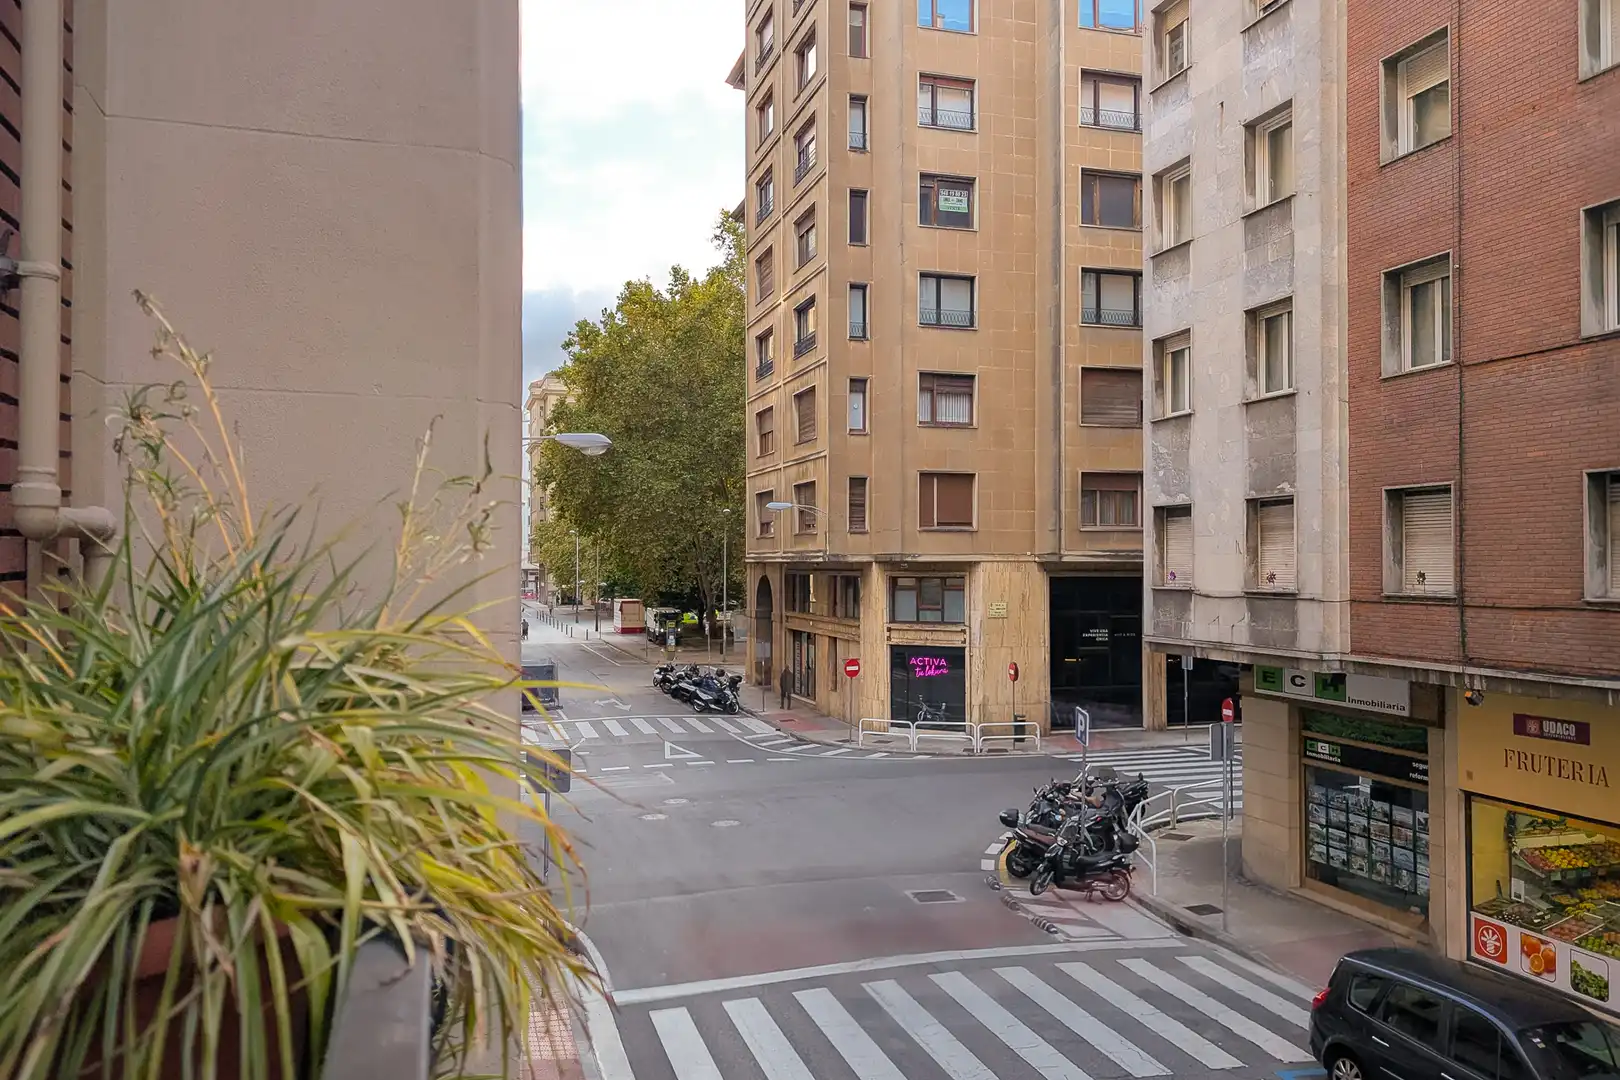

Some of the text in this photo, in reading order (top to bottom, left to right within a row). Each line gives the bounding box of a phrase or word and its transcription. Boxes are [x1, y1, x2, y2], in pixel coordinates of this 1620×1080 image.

[909, 656, 947, 666] ACTIVA
[1347, 696, 1406, 712] Inmobiliaria
[1542, 720, 1576, 736] UDACO
[1503, 748, 1610, 788] FRUTERIA
